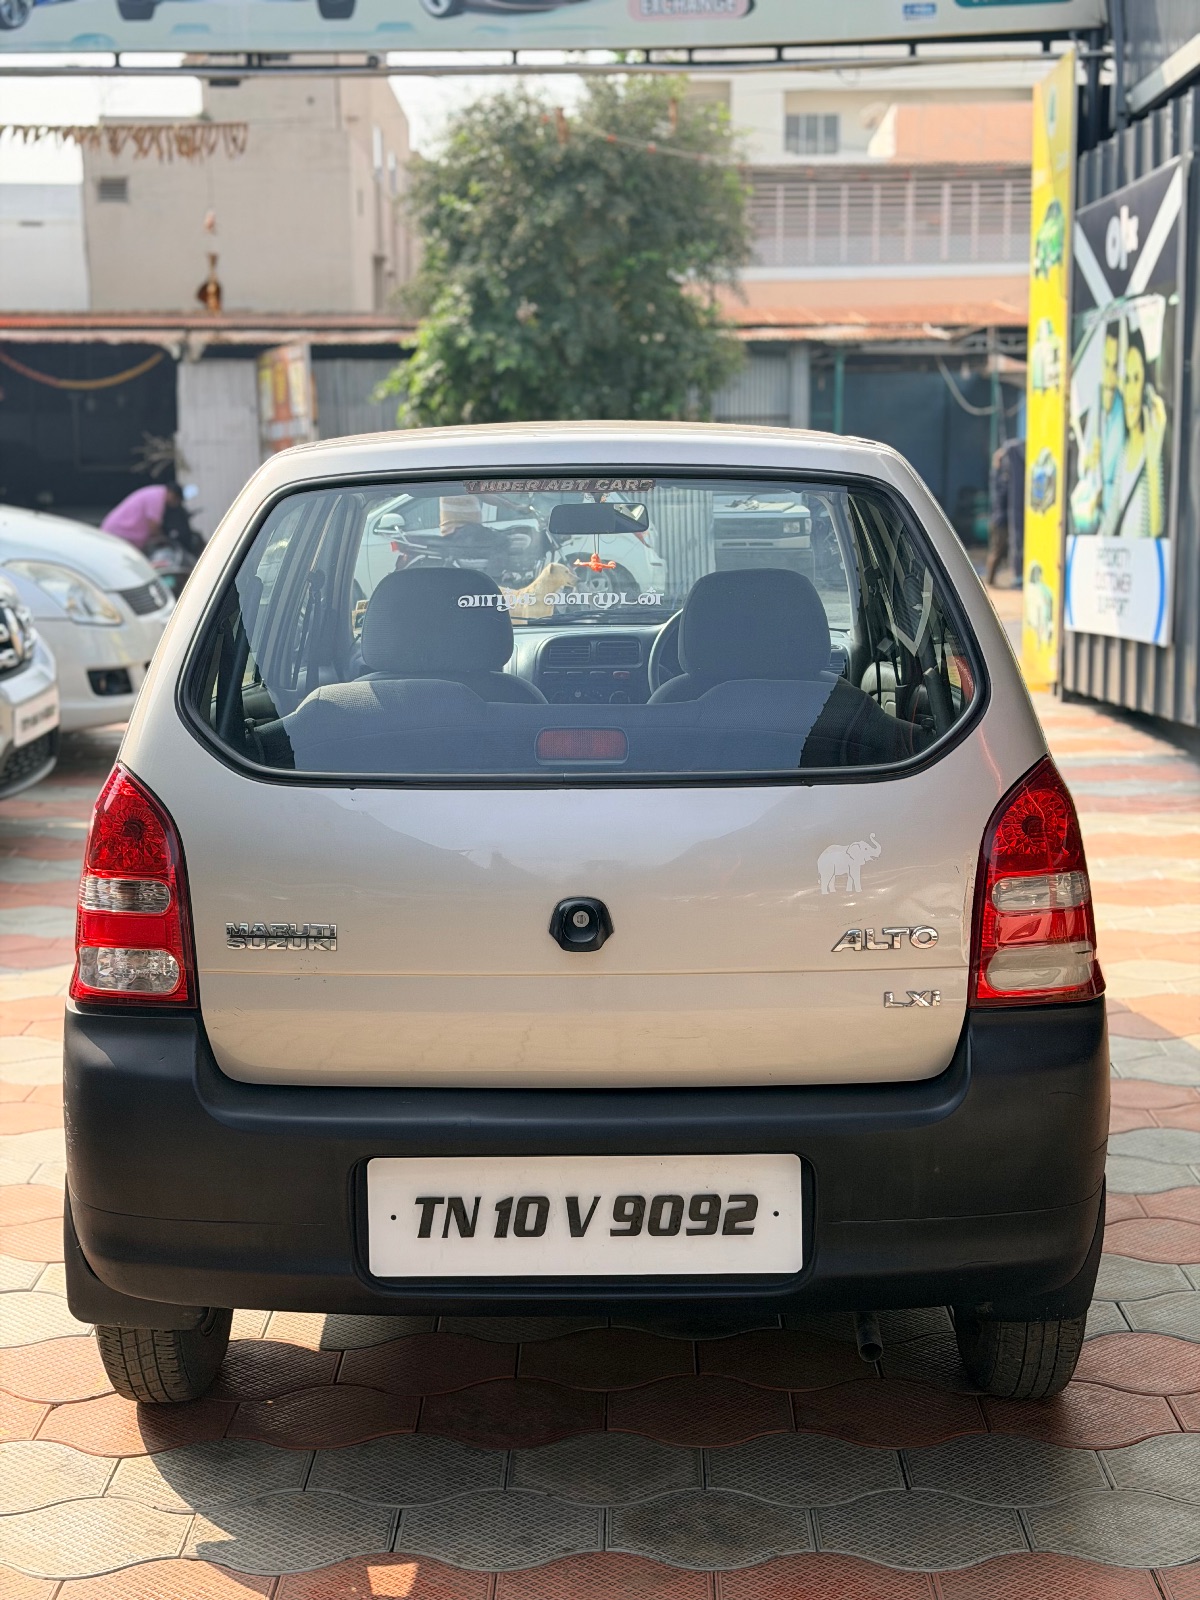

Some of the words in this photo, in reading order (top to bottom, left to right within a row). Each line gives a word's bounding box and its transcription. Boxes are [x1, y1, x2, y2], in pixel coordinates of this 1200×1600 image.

[457, 587, 537, 612] வாழ்க
[543, 587, 665, 610] வளமுடன்
[225, 922, 337, 937] MARUTI
[830, 925, 939, 952] ALTO
[226, 937, 338, 951] SUZUKI
[415, 1196, 482, 1238] TN
[493, 1195, 551, 1238] 10
[565, 1195, 601, 1238] V
[610, 1194, 759, 1237] 9092
